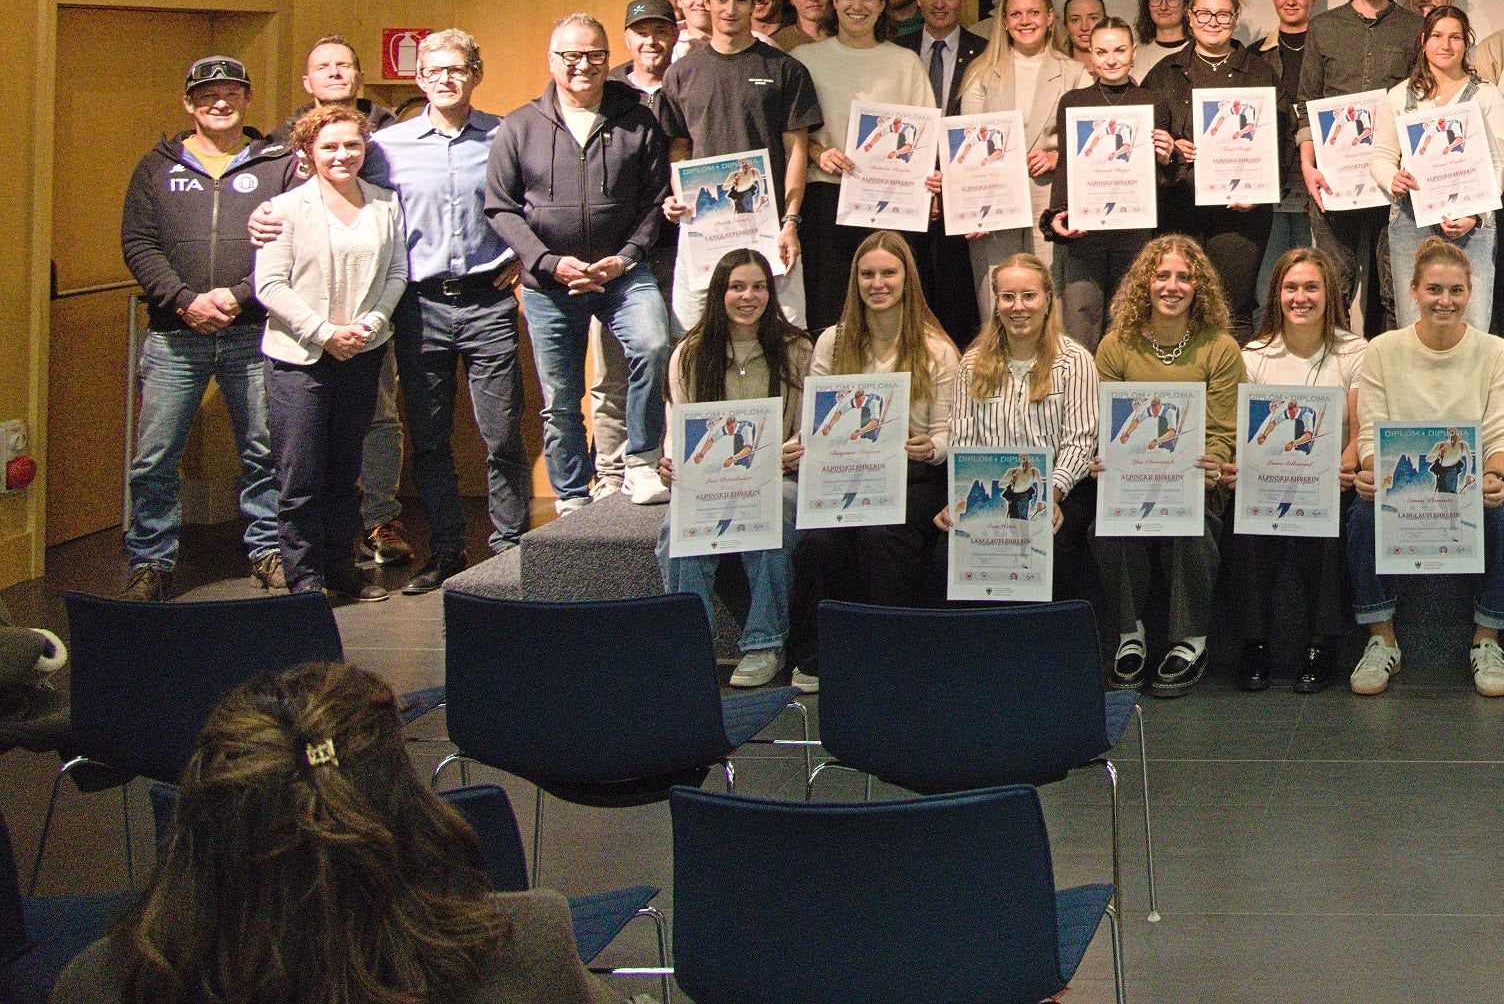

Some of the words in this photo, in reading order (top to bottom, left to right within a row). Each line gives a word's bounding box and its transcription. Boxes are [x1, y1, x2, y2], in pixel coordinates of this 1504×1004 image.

[169, 178, 205, 192] ITA
[1249, 393, 1284, 401] DIPLOM
[1291, 395, 1332, 404] DIPLOMA
[728, 407, 770, 417] DIPLOMA
[1384, 430, 1420, 438] DIPLOM
[958, 455, 993, 464] DIPLOM
